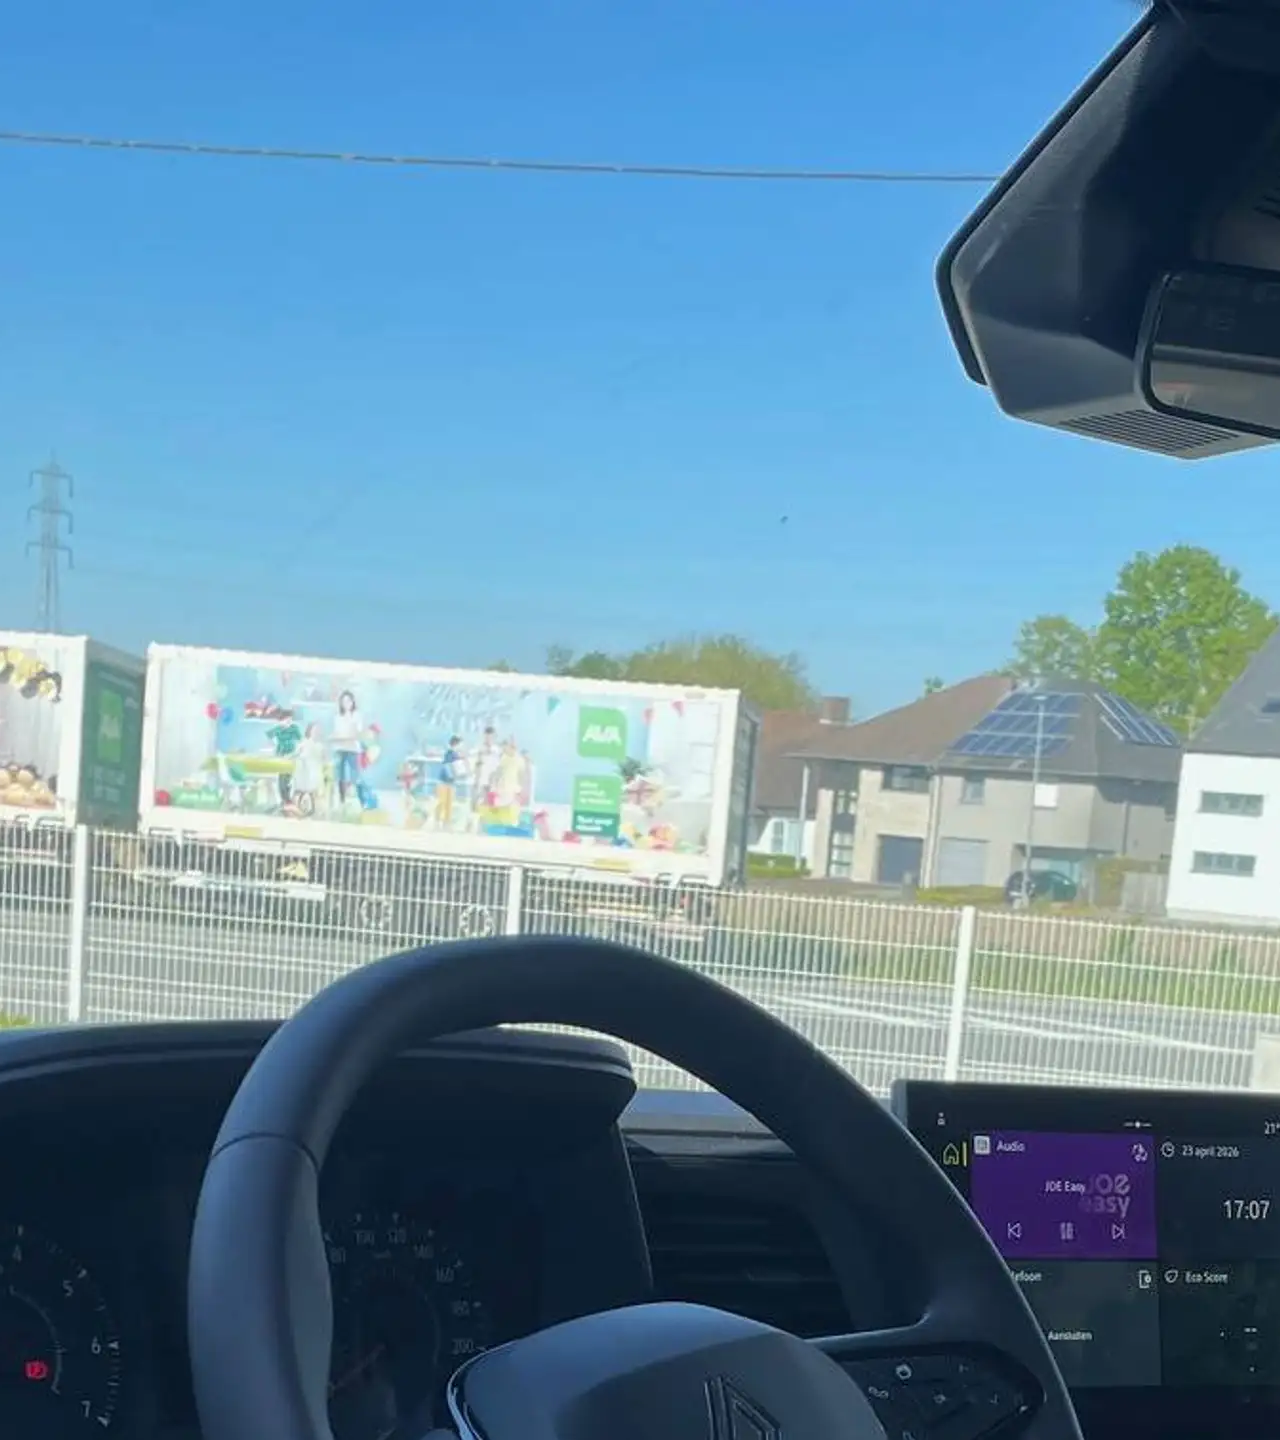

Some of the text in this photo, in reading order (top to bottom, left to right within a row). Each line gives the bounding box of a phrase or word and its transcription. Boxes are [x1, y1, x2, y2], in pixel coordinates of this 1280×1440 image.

[582, 723, 622, 746] AVA
[996, 1140, 1026, 1152] Audio
[1195, 1146, 1215, 1160] april
[1045, 1180, 1063, 1193] JOE
[1223, 1199, 1271, 1220] 17:07
[1185, 1270, 1202, 1284] Eco
[61, 1279, 74, 1297] 5
[90, 1335, 102, 1355] 6
[81, 1400, 92, 1418] 7
